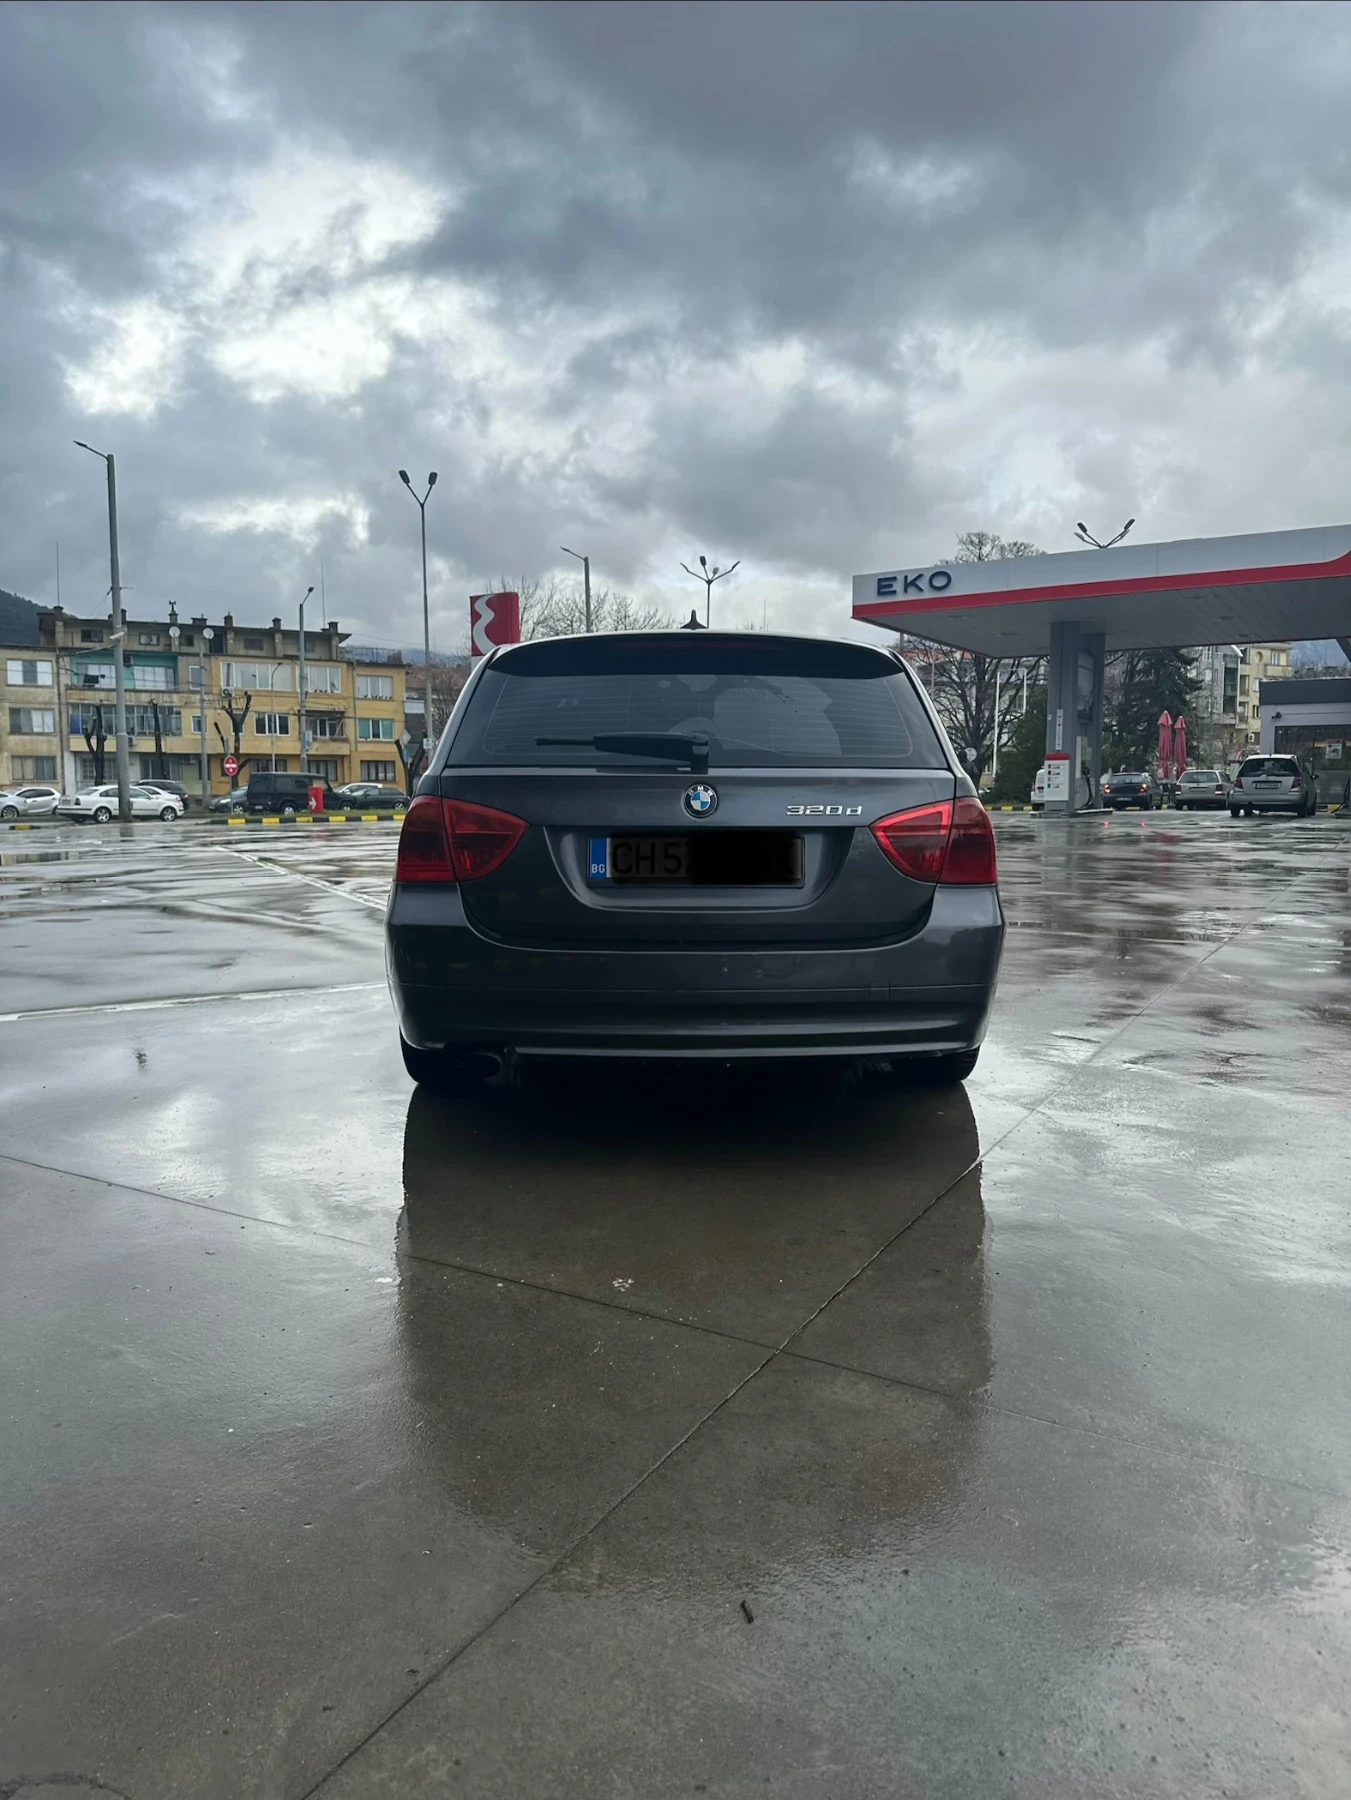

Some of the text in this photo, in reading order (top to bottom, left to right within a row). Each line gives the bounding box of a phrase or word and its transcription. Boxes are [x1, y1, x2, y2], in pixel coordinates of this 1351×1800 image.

[876, 570, 952, 597] EKO
[785, 804, 863, 817] 320d
[590, 863, 606, 874] BG
